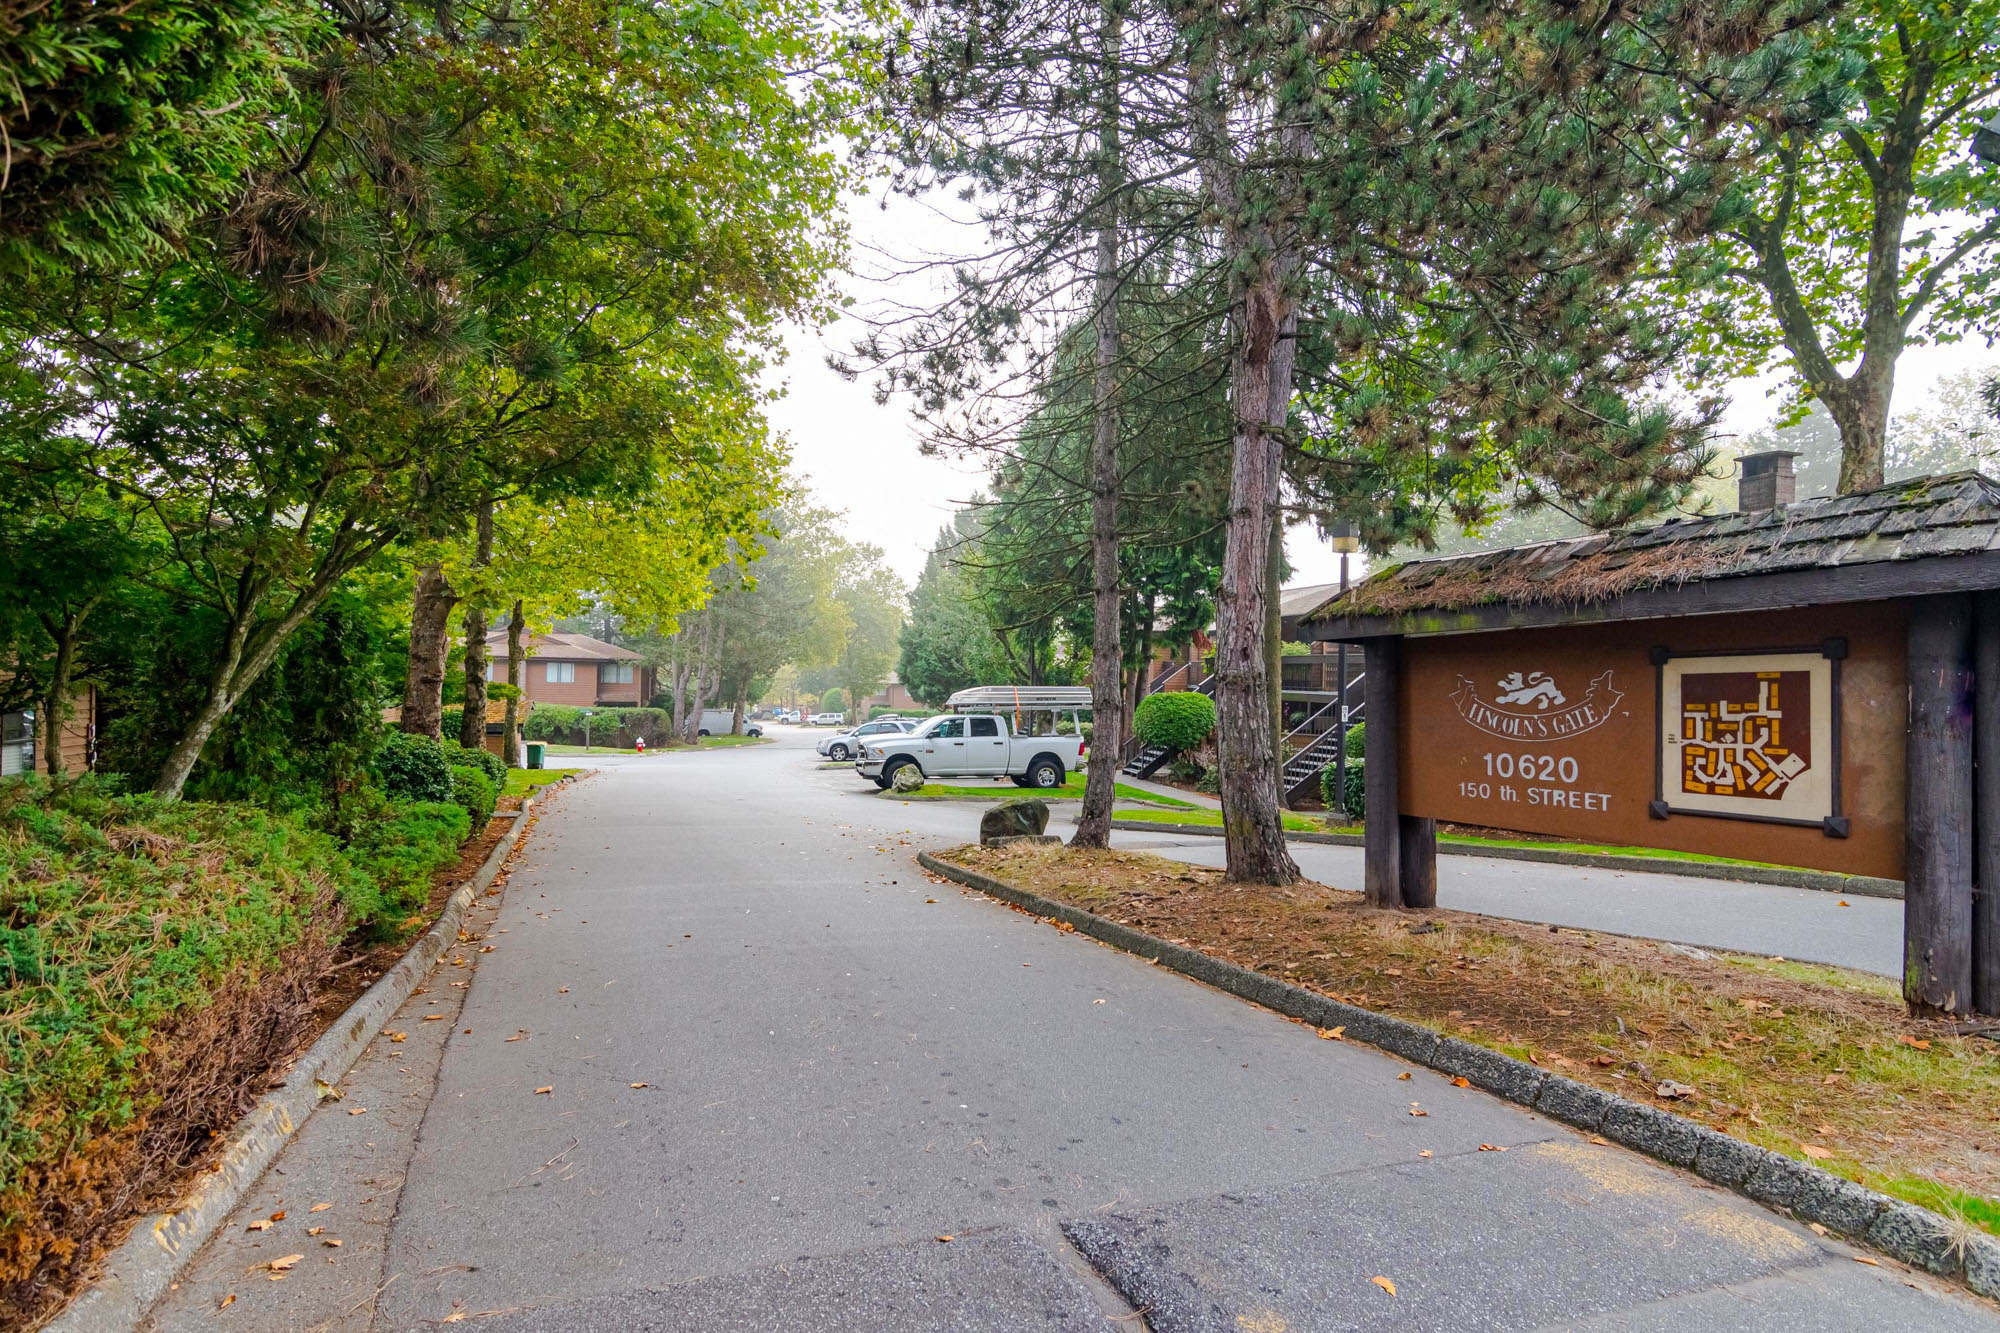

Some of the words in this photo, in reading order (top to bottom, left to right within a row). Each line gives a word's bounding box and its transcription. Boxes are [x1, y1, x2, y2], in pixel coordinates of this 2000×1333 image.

[1469, 703, 1547, 738] LINCOLN'S
[1553, 703, 1598, 735] GATE
[1483, 752, 1579, 783] 10620
[1458, 782, 1490, 799] 150
[1527, 787, 1612, 811] STREET
